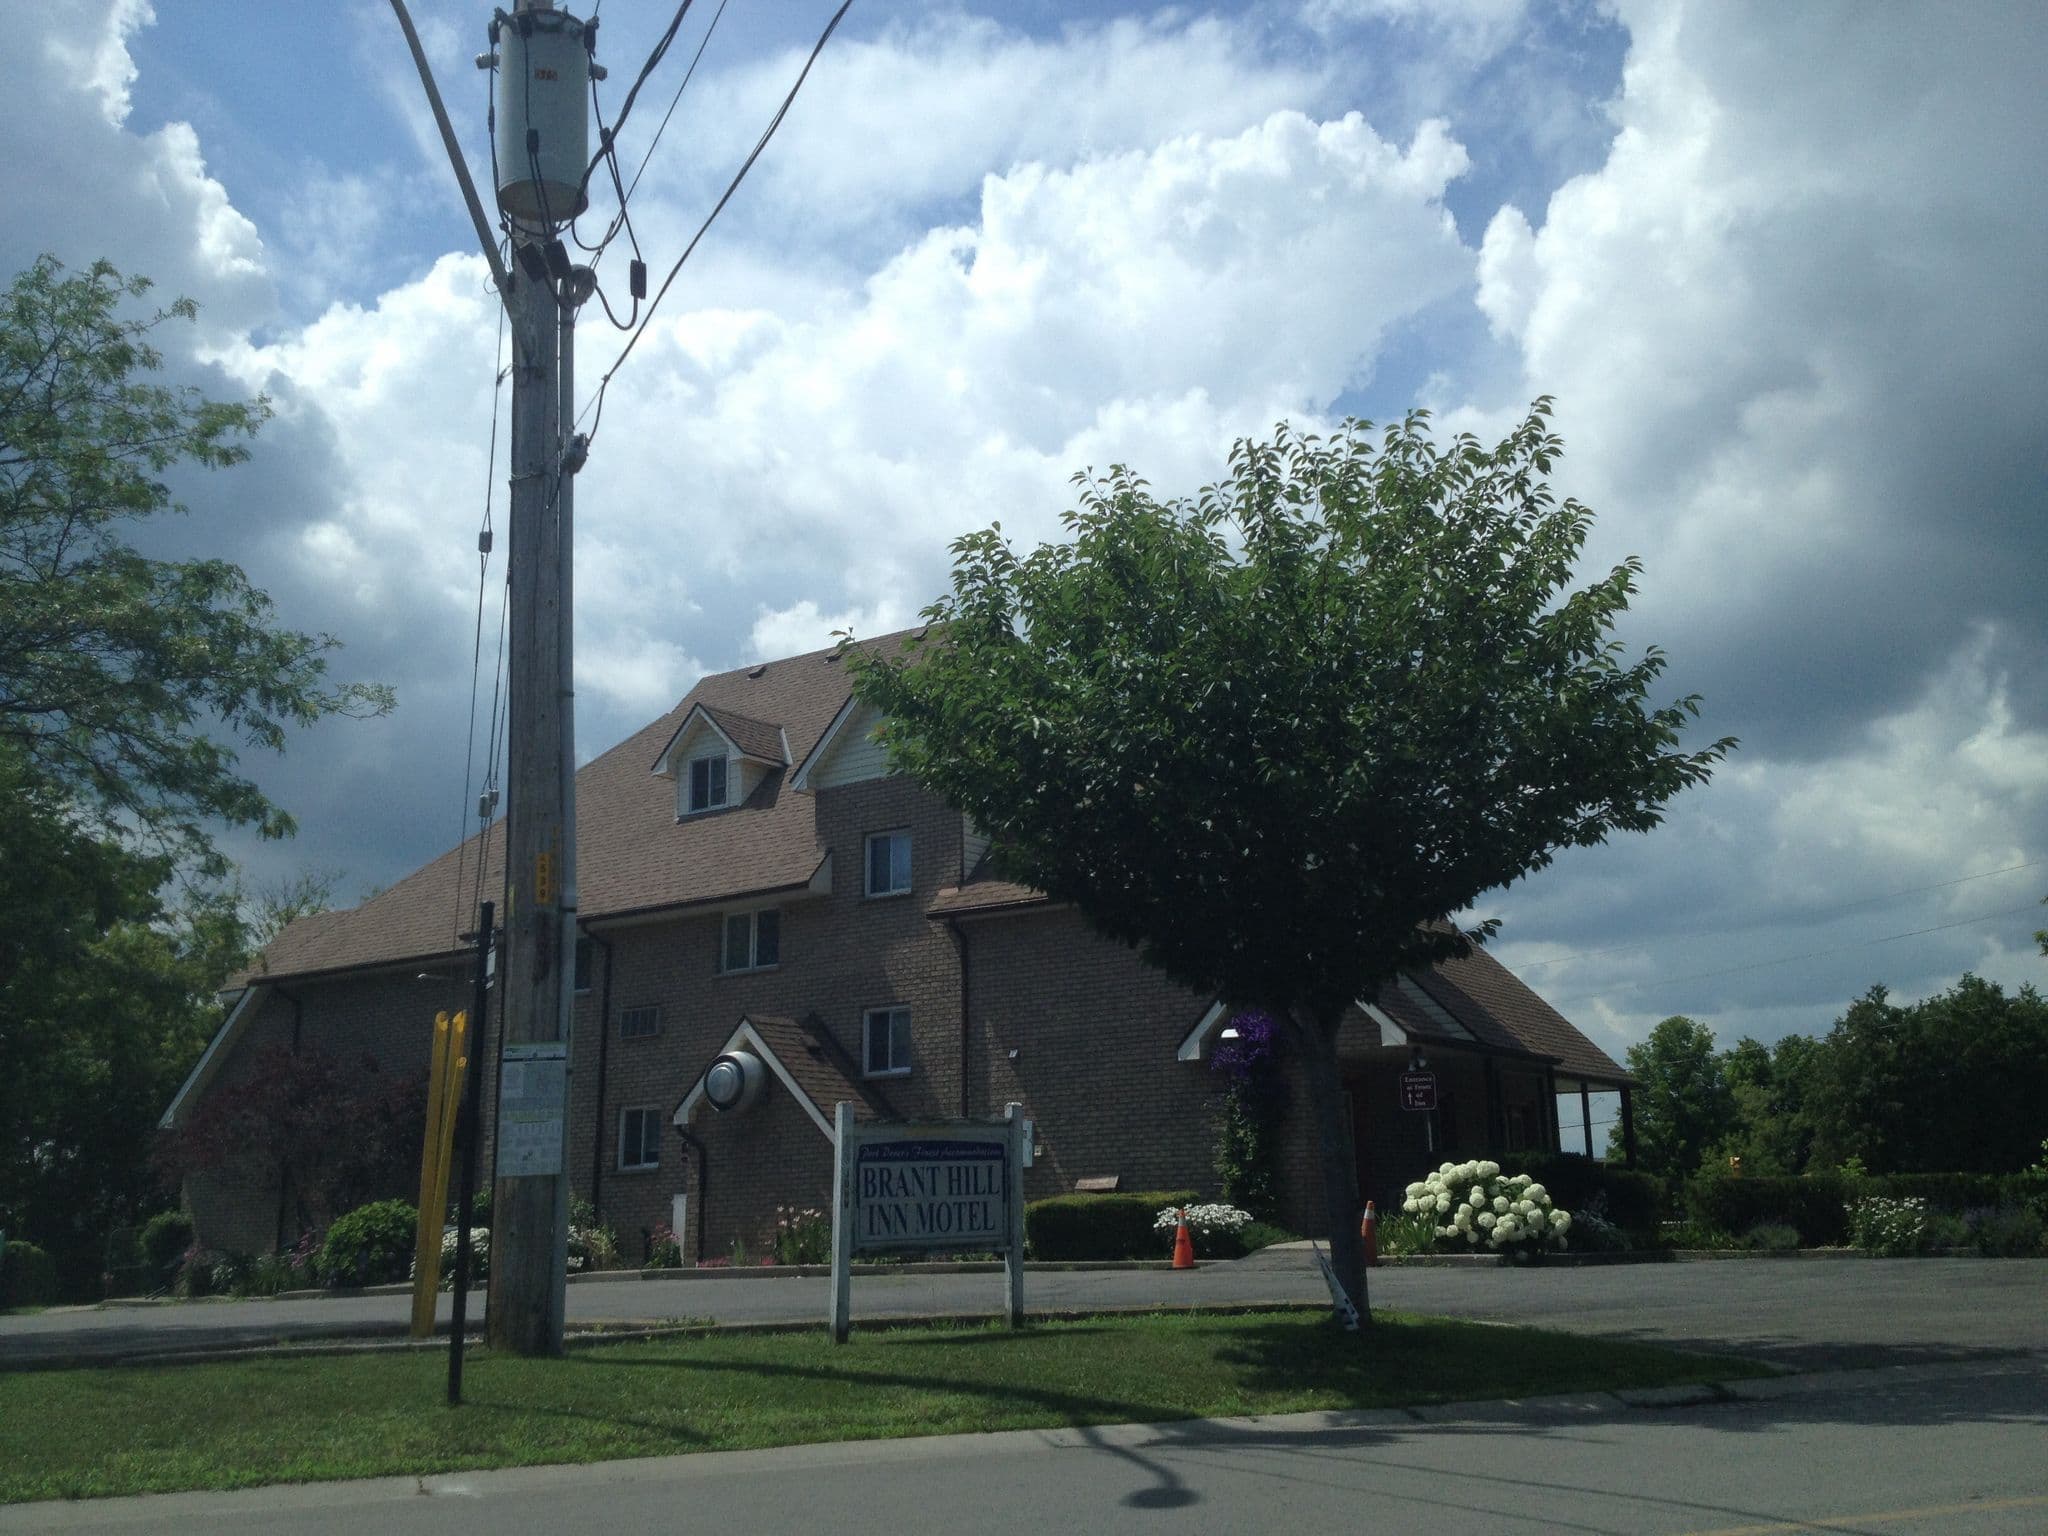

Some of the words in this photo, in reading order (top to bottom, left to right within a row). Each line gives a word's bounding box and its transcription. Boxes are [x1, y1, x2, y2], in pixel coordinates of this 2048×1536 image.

[863, 1166, 940, 1198] BRANT
[946, 1165, 1001, 1195] HILL
[866, 1203, 908, 1236] INN
[915, 1201, 996, 1233] MOTEL
